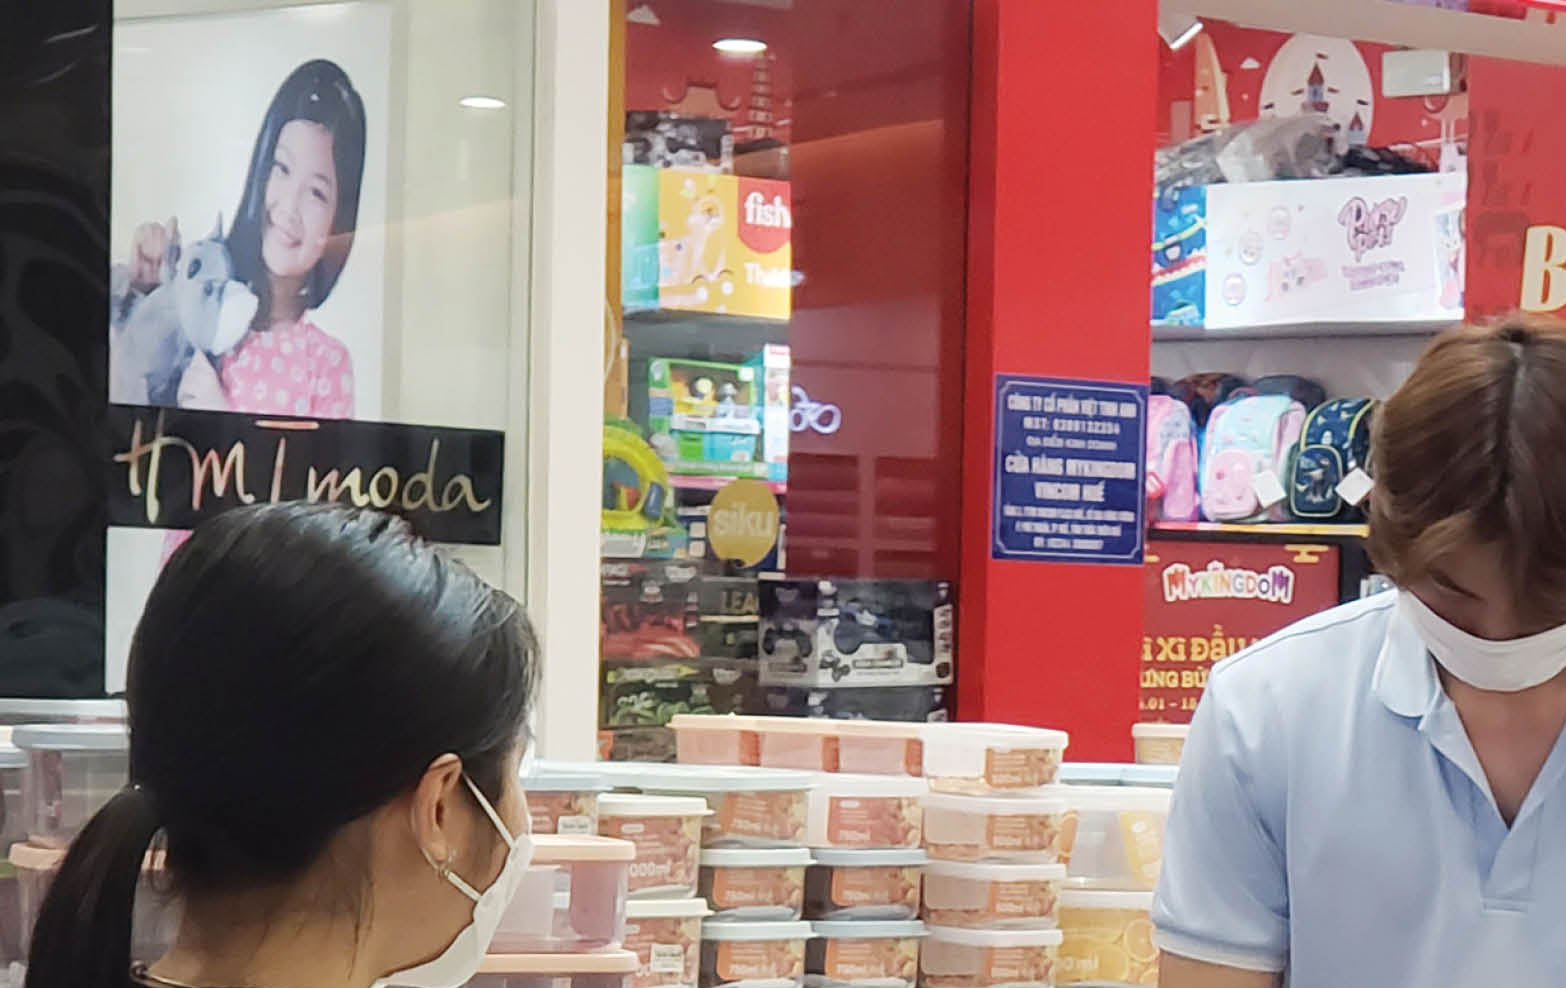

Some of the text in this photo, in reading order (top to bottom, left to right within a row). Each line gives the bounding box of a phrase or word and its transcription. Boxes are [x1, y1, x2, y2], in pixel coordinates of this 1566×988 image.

[744, 192, 792, 228] fish
[307, 438, 491, 512] moda
[713, 503, 775, 538] siku
